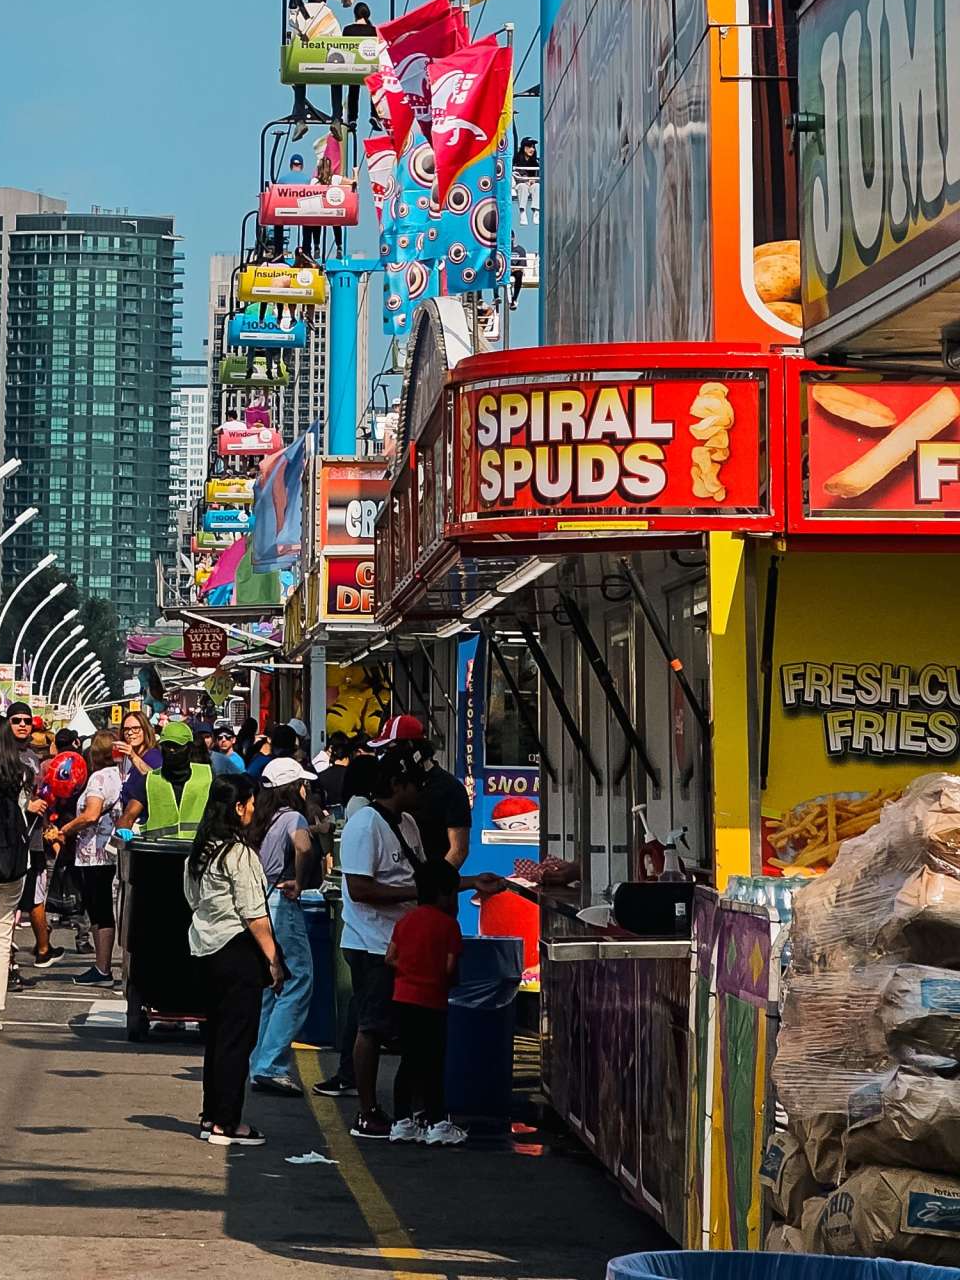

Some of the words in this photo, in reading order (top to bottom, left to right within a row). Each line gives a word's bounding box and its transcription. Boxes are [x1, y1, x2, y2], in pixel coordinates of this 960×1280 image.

[301, 40, 325, 50] Heat
[326, 41, 360, 51] pumps
[277, 188, 327, 199] Windows
[477, 385, 674, 447] SPIRAL
[479, 441, 668, 502] SPUDS
[188, 633, 224, 642] WIN
[191, 642, 221, 651] BIG
[466, 698, 474, 739] COLD
[826, 711, 959, 753] FRIES
[487, 776, 528, 794] SNO
